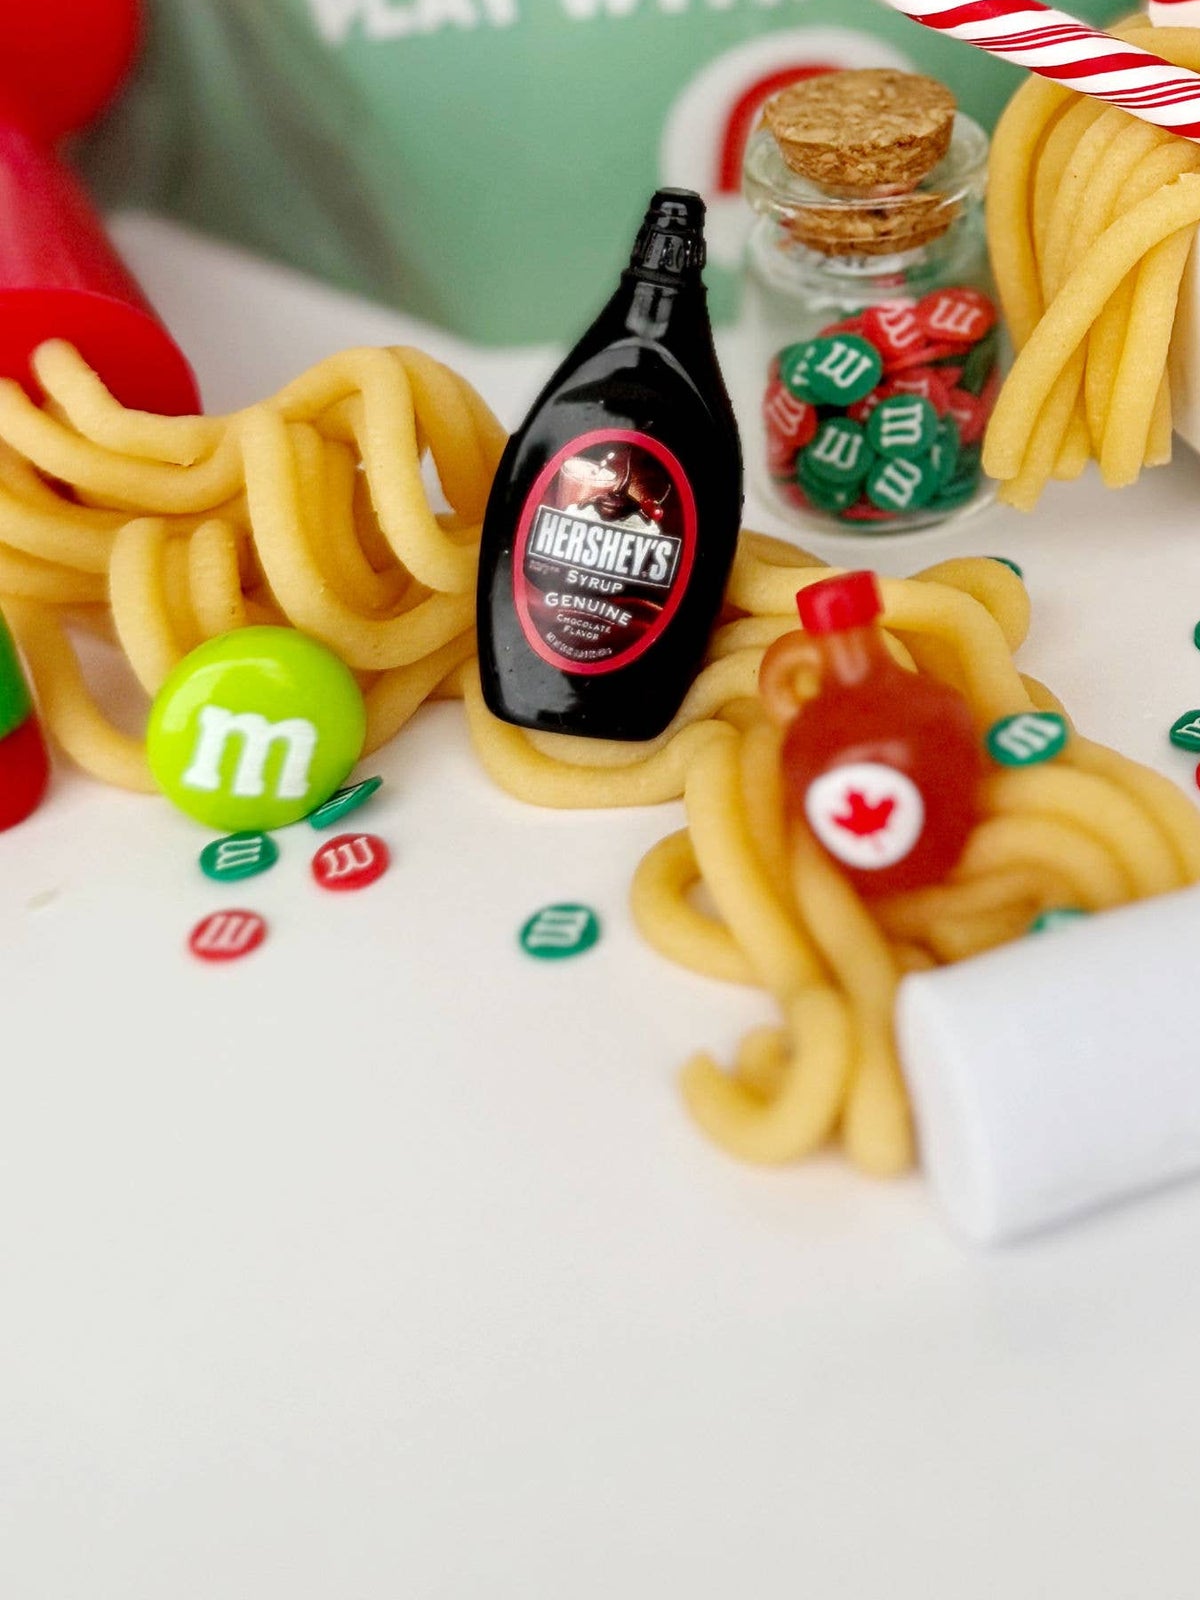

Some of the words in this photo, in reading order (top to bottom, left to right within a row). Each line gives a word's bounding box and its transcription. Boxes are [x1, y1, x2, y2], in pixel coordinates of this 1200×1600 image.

[534, 512, 673, 582] HERSHEY'S
[566, 569, 624, 595] SYRUP
[543, 591, 633, 627] GENUINE
[555, 613, 613, 635] CHOCOLATE
[562, 625, 601, 642] FLAVOR
[181, 703, 319, 799] m
